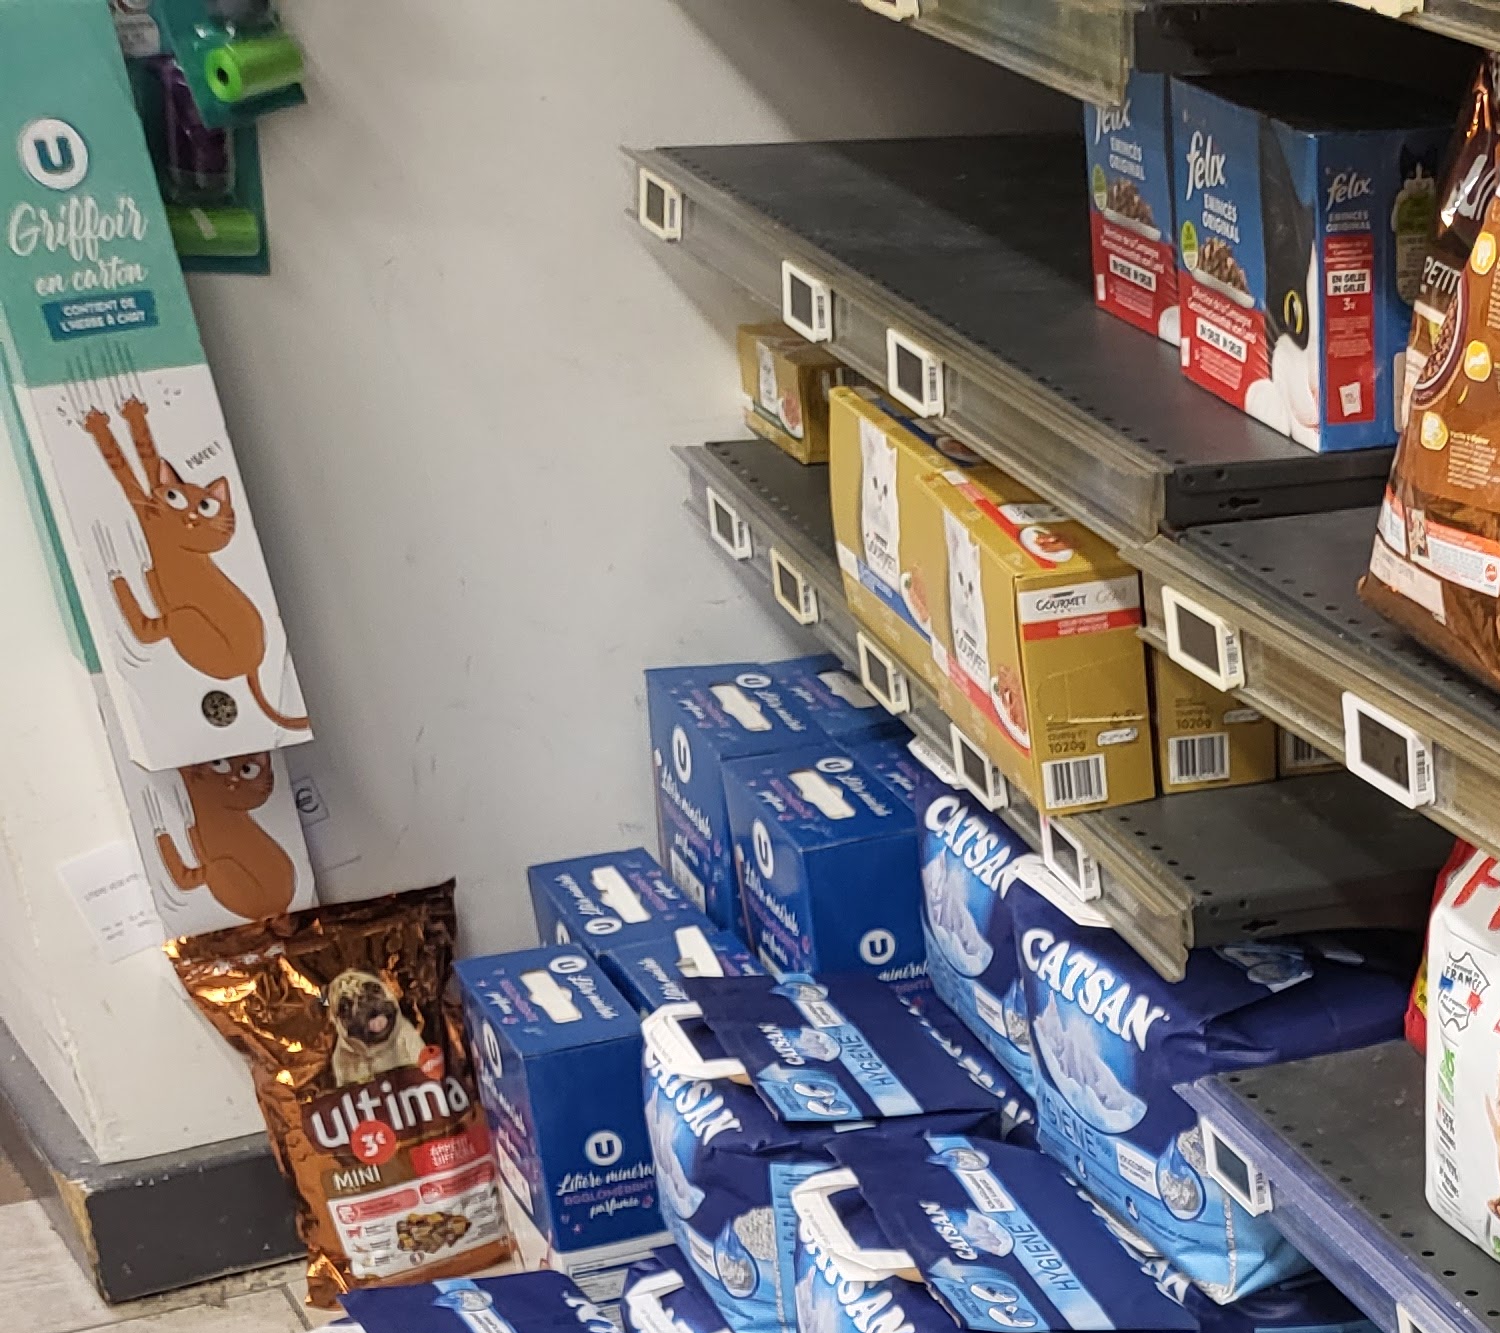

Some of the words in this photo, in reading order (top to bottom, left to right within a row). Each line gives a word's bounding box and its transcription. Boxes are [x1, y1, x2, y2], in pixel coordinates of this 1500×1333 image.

[33, 135, 76, 175] U
[1185, 130, 1226, 201] felix
[1325, 171, 1373, 211] felix
[9, 195, 148, 262] Griffoir
[36, 271, 67, 296] en
[72, 255, 147, 292] carton
[1035, 594, 1088, 614] GOURMET
[925, 795, 1022, 899] CATSAN
[868, 938, 889, 958] U
[1021, 929, 1164, 1052] CATSAN
[1444, 964, 1482, 991] FRANCE
[836, 1033, 895, 1088] HYGIENE
[311, 1076, 471, 1149] ultima
[594, 1139, 615, 1158] U
[333, 1164, 382, 1192] MINI
[918, 1199, 979, 1262] CATSAN
[1008, 1221, 1081, 1295] HYGIENE
